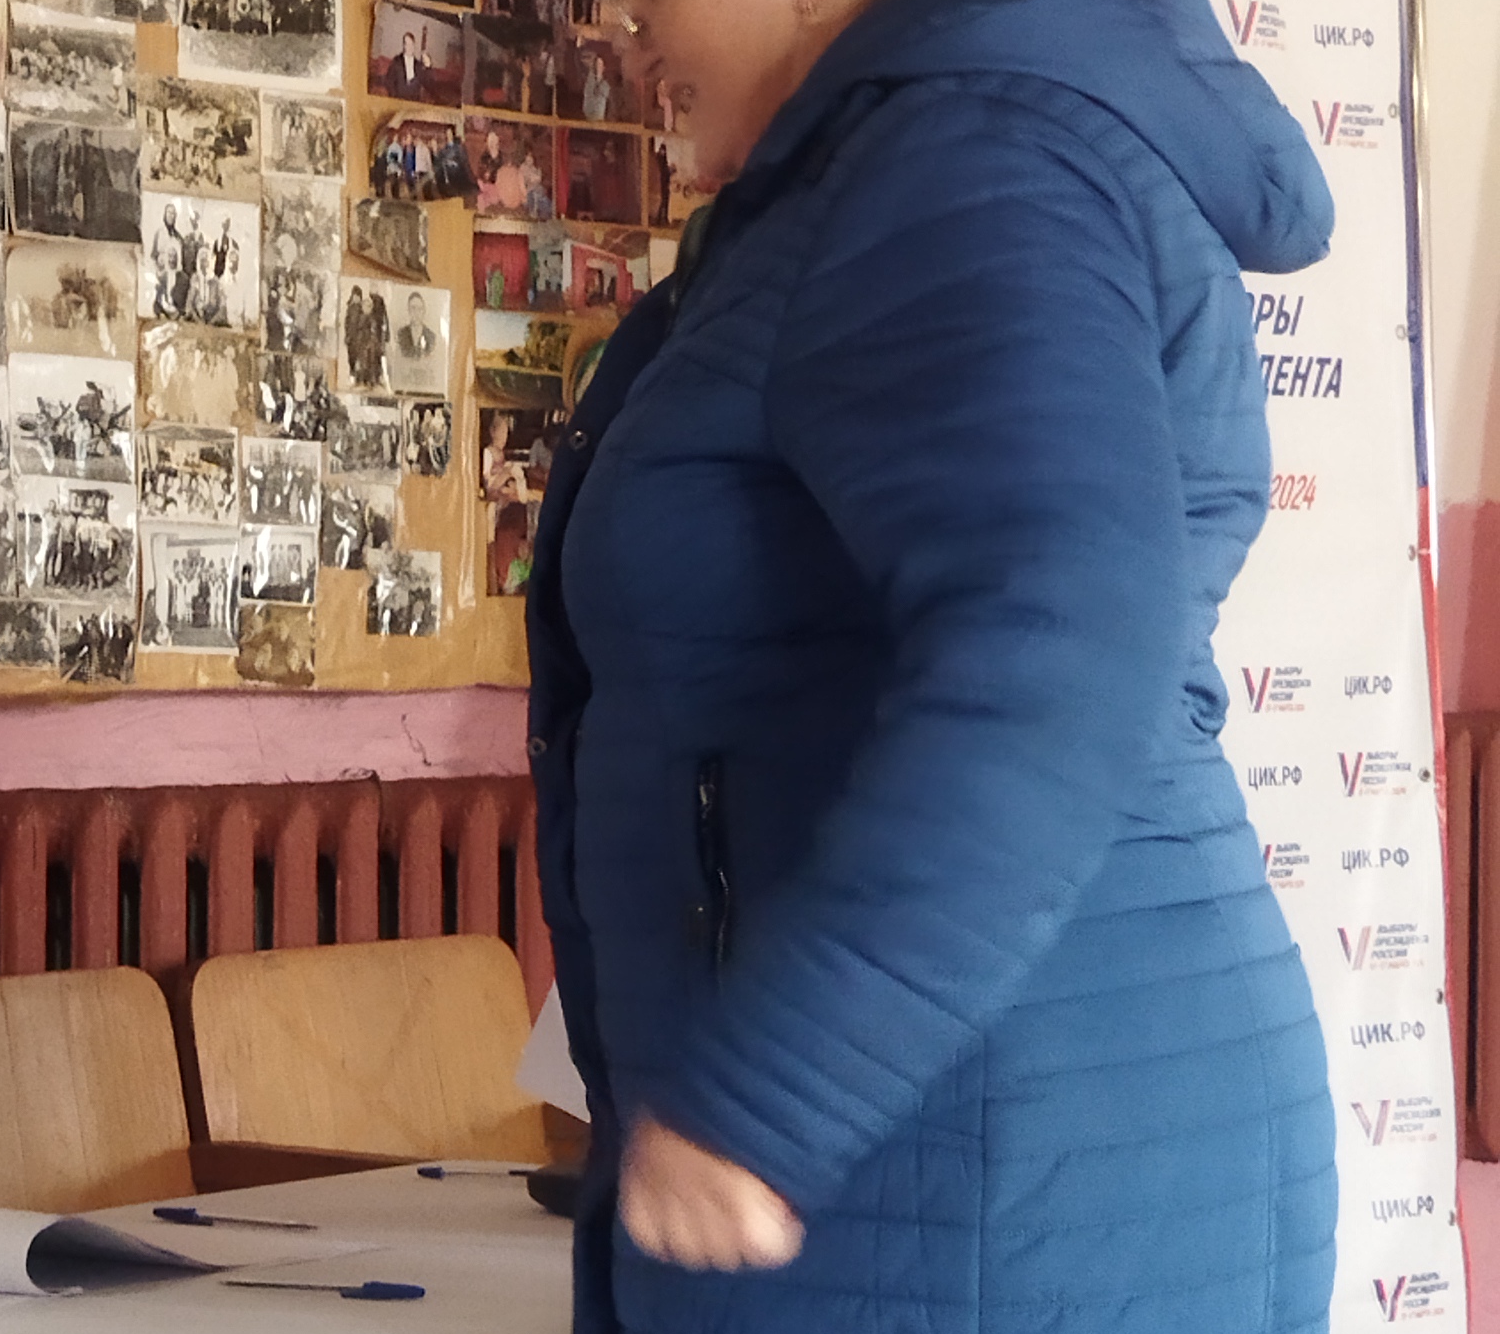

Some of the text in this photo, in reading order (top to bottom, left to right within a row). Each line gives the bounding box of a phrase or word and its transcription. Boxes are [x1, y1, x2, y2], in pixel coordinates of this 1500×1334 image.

[1313, 24, 1374, 48] ЦИК.РФ
[1270, 474, 1316, 510] 2024
[1344, 675, 1392, 699] ЦИК.РФ
[1248, 765, 1302, 790] ЦИК.РФ
[1341, 847, 1410, 873] ЦИК.РФ
[1350, 1020, 1425, 1049] ЦИК.РФ
[1371, 1195, 1434, 1223] ЦИК.РФ
